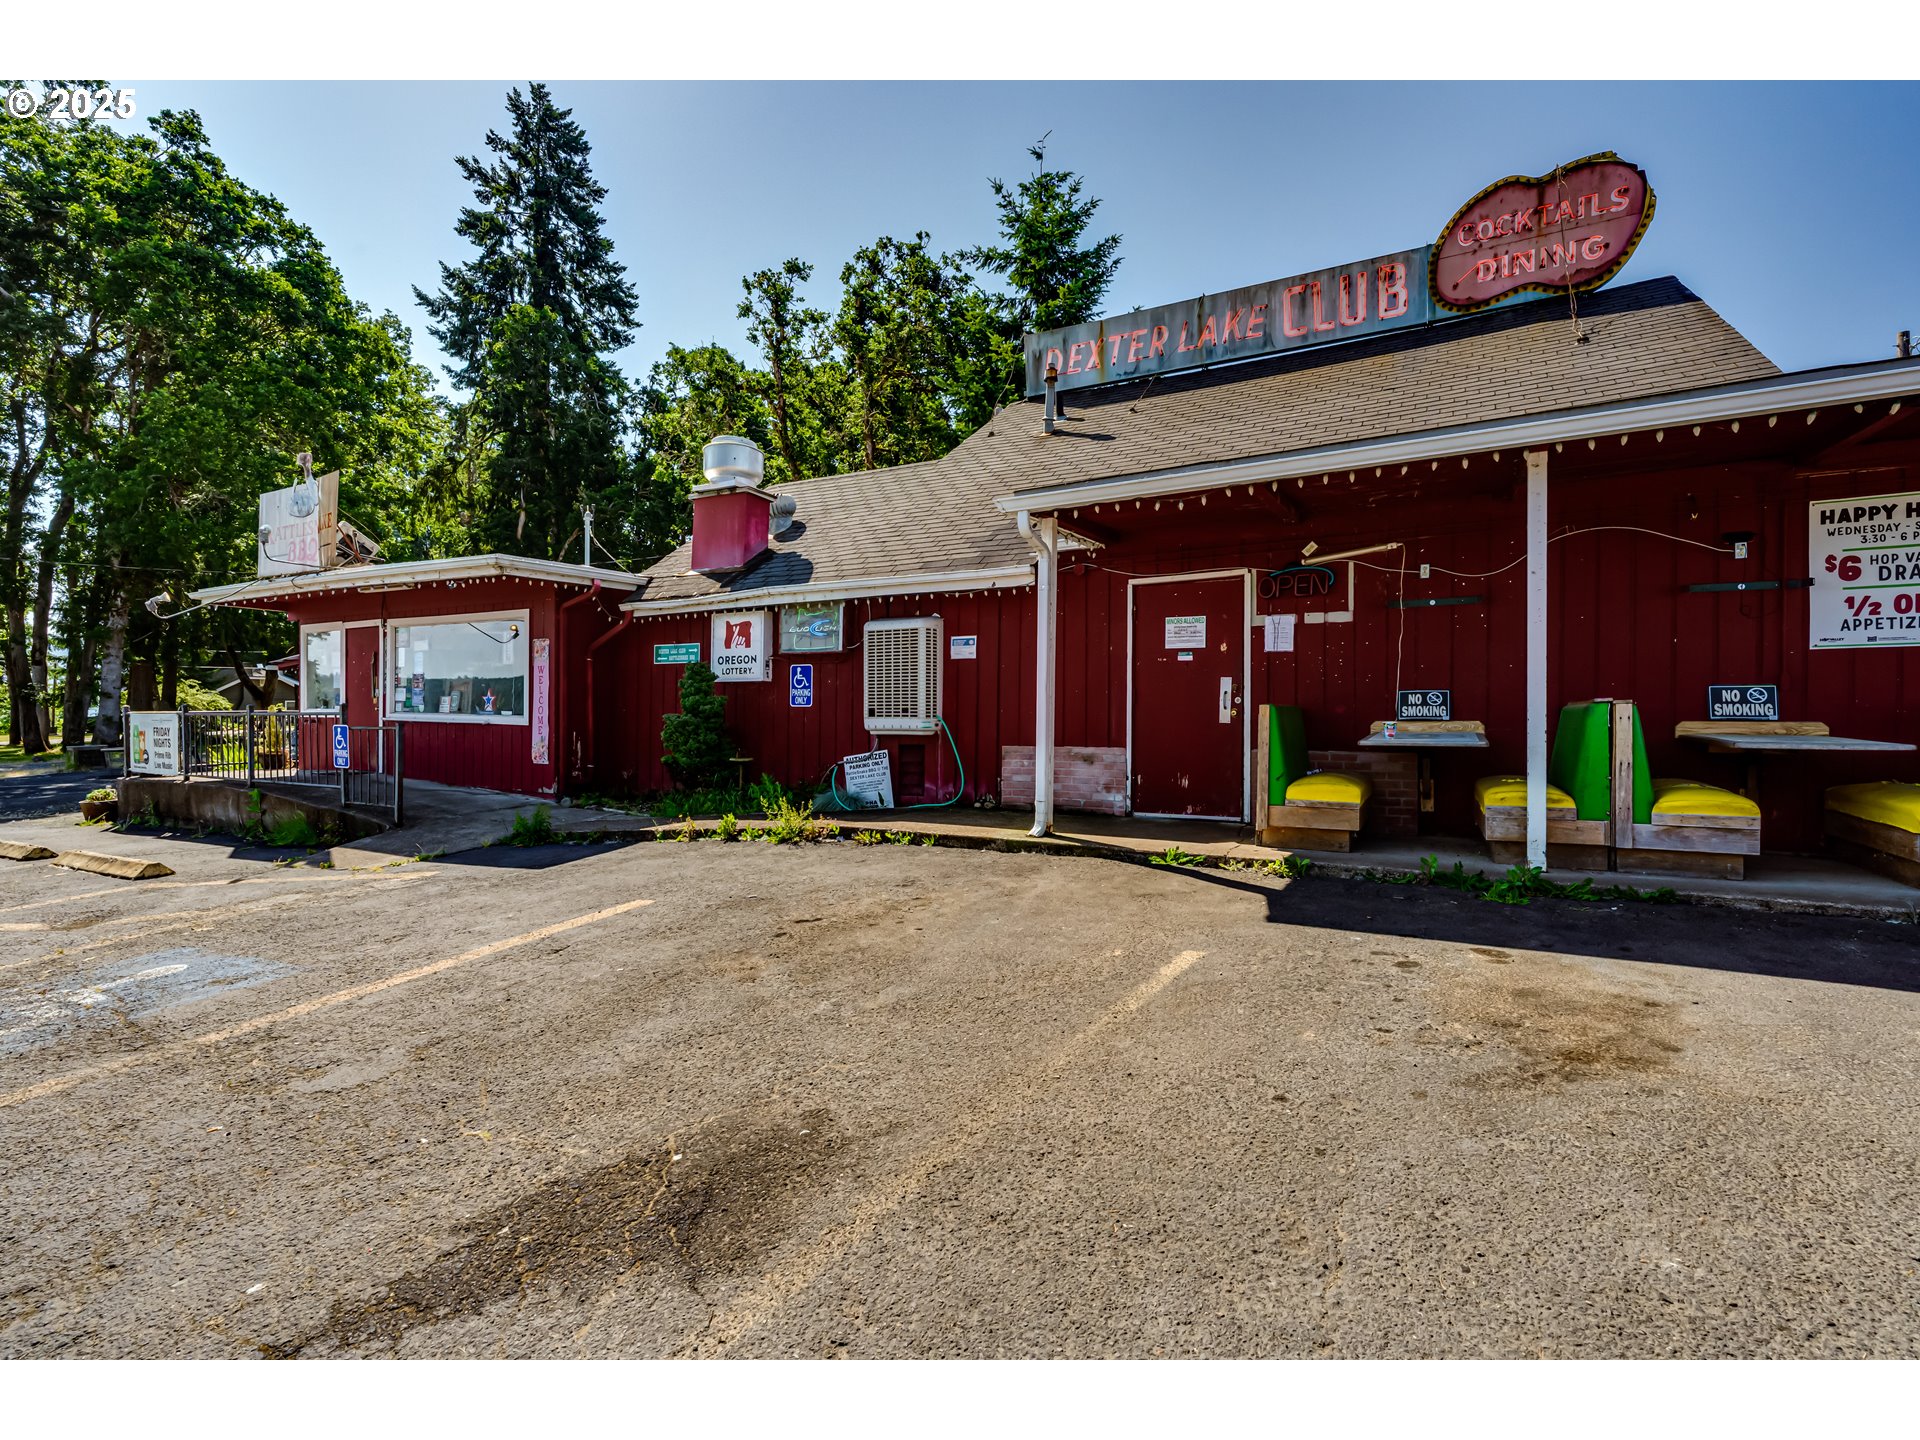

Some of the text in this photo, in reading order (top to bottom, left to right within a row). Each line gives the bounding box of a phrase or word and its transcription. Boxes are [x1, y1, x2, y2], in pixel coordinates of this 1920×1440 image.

[1457, 185, 1630, 247] COCKTAILS
[1476, 235, 1606, 283] DINING
[1045, 262, 1410, 377] DEXTER LAKE CLUB
[1820, 503, 1898, 525] HAPPY
[1827, 522, 1901, 537] WEDNESDAY
[1860, 534, 1887, 544] 3:30
[1900, 531, 1907, 541] 6
[288, 537, 318, 563] BBQ
[1870, 553, 1899, 565] HOP
[1824, 554, 1862, 581] $6
[1258, 573, 1329, 598] OPEN
[1893, 593, 1920, 614] O
[1840, 615, 1920, 631] APPETIZ
[717, 655, 757, 665] OREGON
[721, 667, 753, 675] LOTTERY
[791, 688, 810, 696] PARKING
[1722, 689, 1740, 702] NO
[537, 665, 545, 735] WELCOME
[1408, 694, 1422, 704] NO
[1402, 706, 1446, 717] SMOKING
[1714, 703, 1774, 716] SMOKING
[153, 727, 170, 737] FRIDAY
[153, 738, 171, 748] NIGHTS
[849, 762, 870, 770] PARKING
